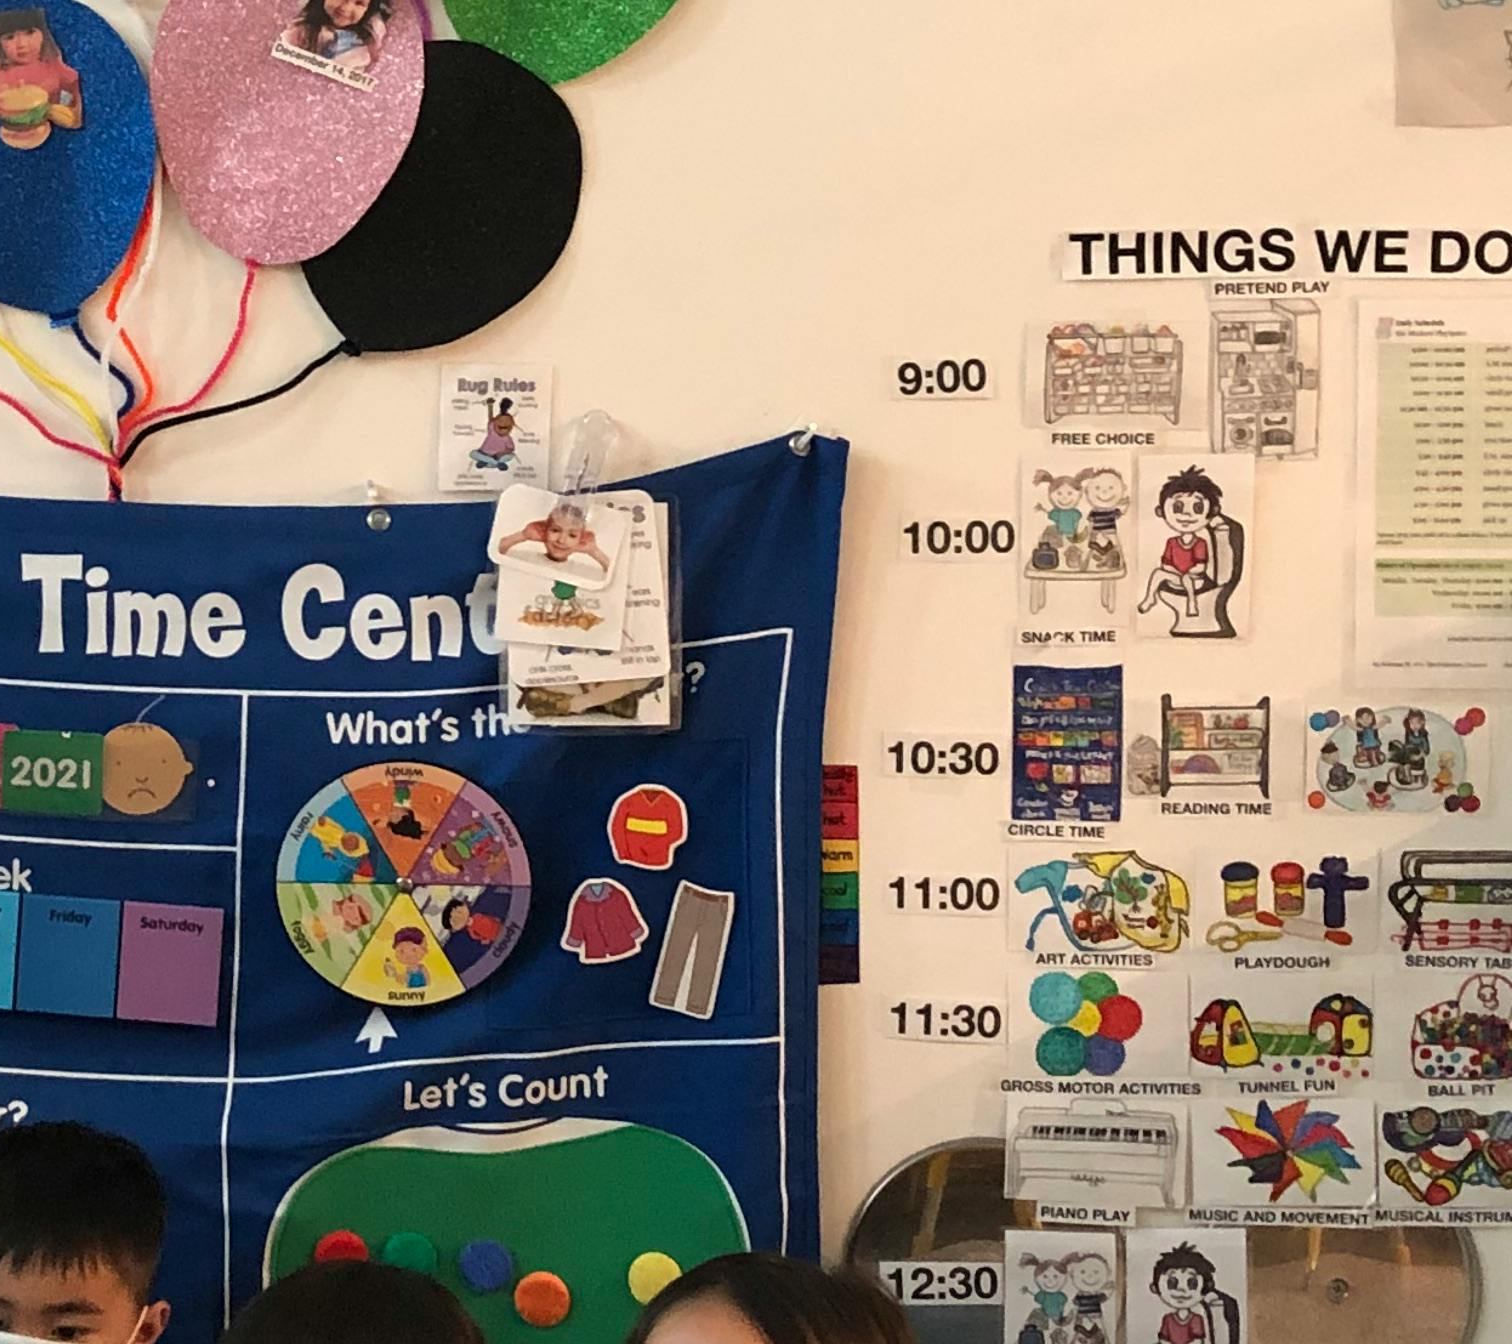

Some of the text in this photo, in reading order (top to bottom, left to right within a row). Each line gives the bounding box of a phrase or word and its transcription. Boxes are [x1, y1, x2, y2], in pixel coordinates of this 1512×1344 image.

[274, 42, 331, 69] December
[348, 69, 375, 87] 2017
[1068, 228, 1512, 276] THINGS WE DO
[1213, 281, 1331, 296] PRETEND PLAY
[457, 376, 537, 396] Rug Rules
[896, 358, 988, 396] 9:00
[1051, 431, 1156, 447] FREE CHOICE
[902, 519, 1016, 555] 10:00
[20, 552, 248, 659] Time
[1079, 629, 1117, 643] TIME
[325, 707, 461, 746] What's
[886, 740, 1001, 776] 10:30
[9, 755, 92, 790] 2021
[384, 765, 425, 778] windy
[1160, 801, 1273, 817] READING TIME
[290, 811, 315, 841] rainy
[490, 810, 519, 849] snowy
[1007, 823, 1106, 840] CIRCLE TIME
[887, 875, 1001, 912] 11:00
[48, 907, 93, 928] Friday
[139, 915, 205, 936] Saturday
[290, 919, 316, 956] foggy
[492, 920, 521, 959] cloudy
[1035, 953, 1154, 967] ART ACTIVITIES
[1233, 955, 1331, 970] PLAYDOUGH
[1404, 955, 1479, 969] SENSORY
[387, 990, 426, 1002] sunny
[889, 1004, 1003, 1037] 11:30
[403, 1064, 609, 1112] Let's Count
[1000, 1079, 1202, 1097] GROSS MOTOR ACTIVITIES
[1238, 1079, 1336, 1095] TUNNEL FUN
[1427, 1083, 1497, 1099] BALL PIT
[1040, 1206, 1131, 1223] PIANO PLAY
[1188, 1209, 1370, 1225] MUSIC AND MOVEMENT
[1374, 1209, 1444, 1223] MUSICAL
[886, 1264, 1000, 1302] 12:30
